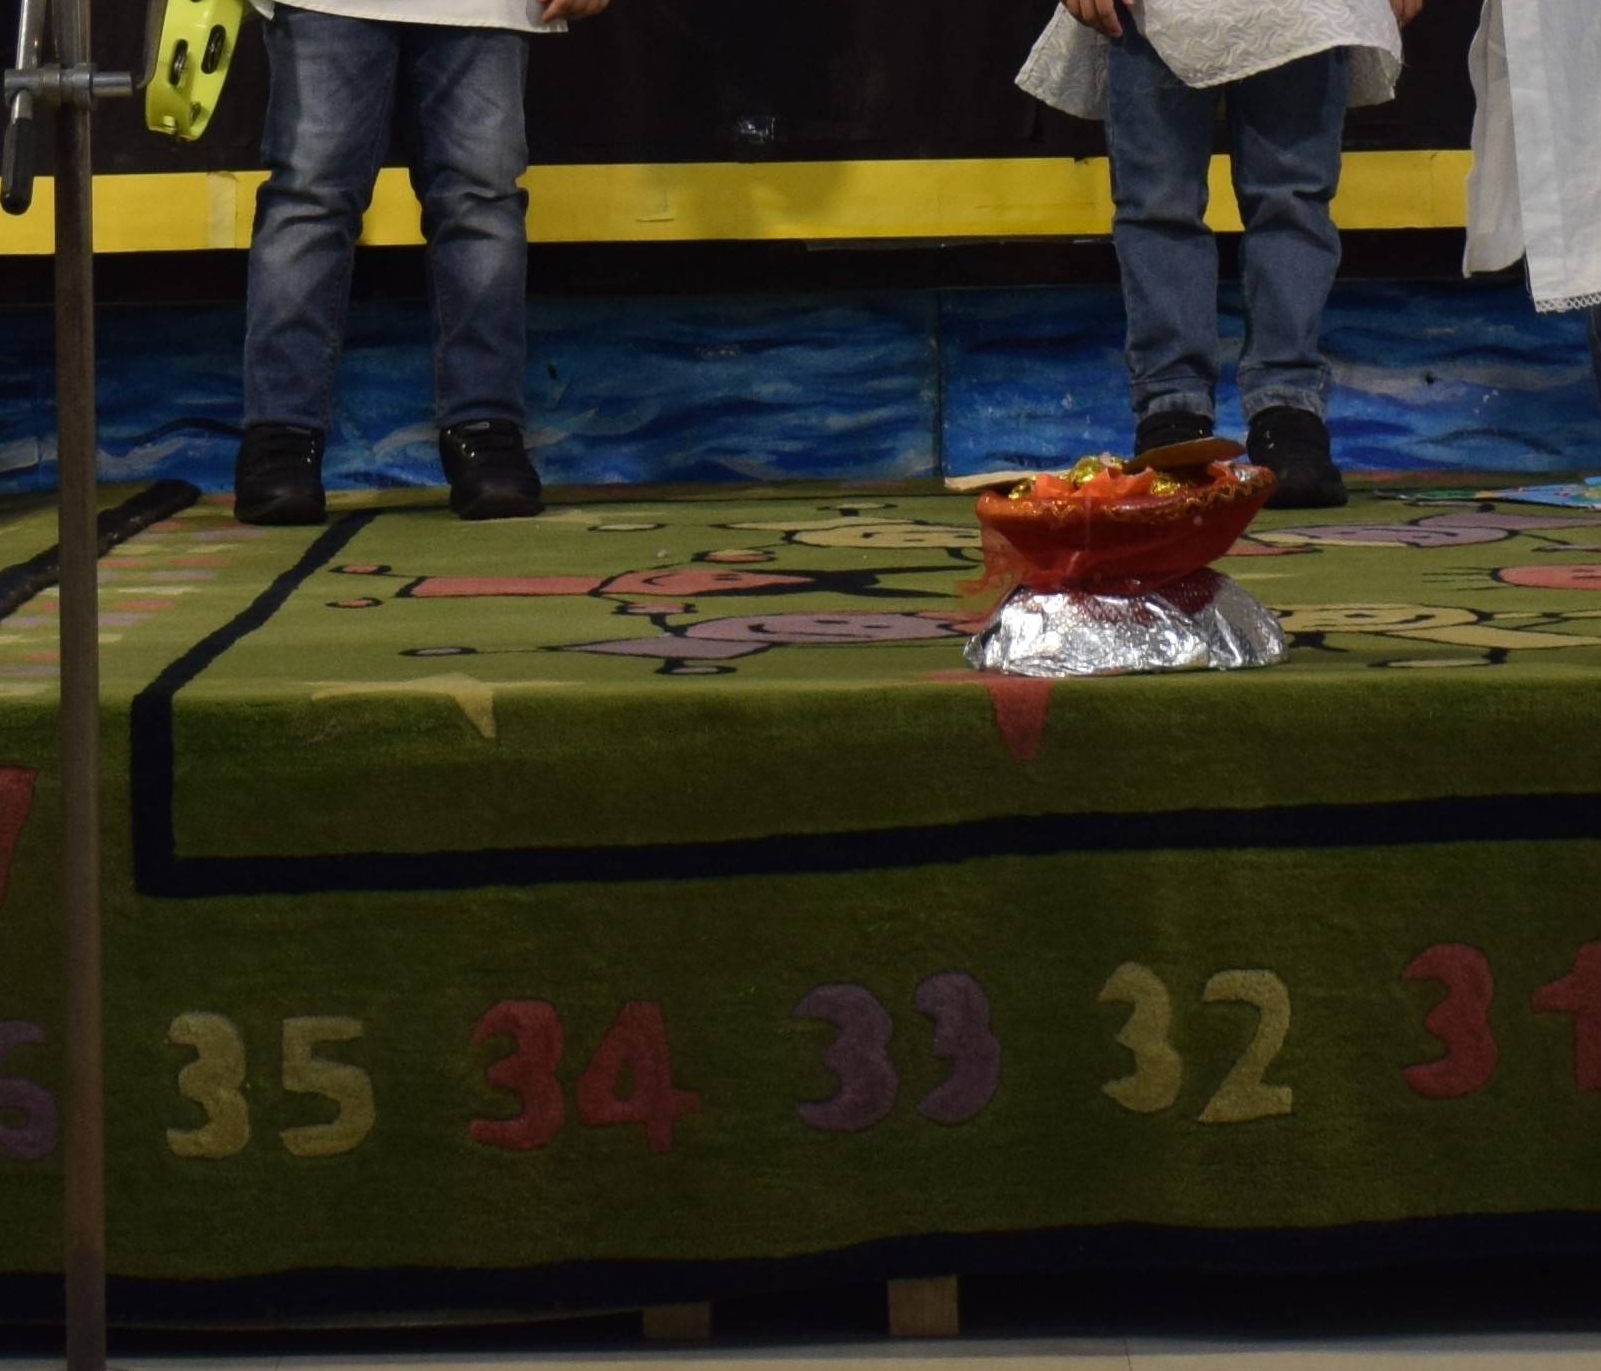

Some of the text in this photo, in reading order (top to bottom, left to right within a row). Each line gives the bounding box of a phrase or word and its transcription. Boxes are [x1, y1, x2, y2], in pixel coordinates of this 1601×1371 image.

[165, 1010, 377, 1159] 35
[468, 997, 701, 1152] 34
[797, 969, 1000, 1132] 33
[1097, 961, 1292, 1123] 32
